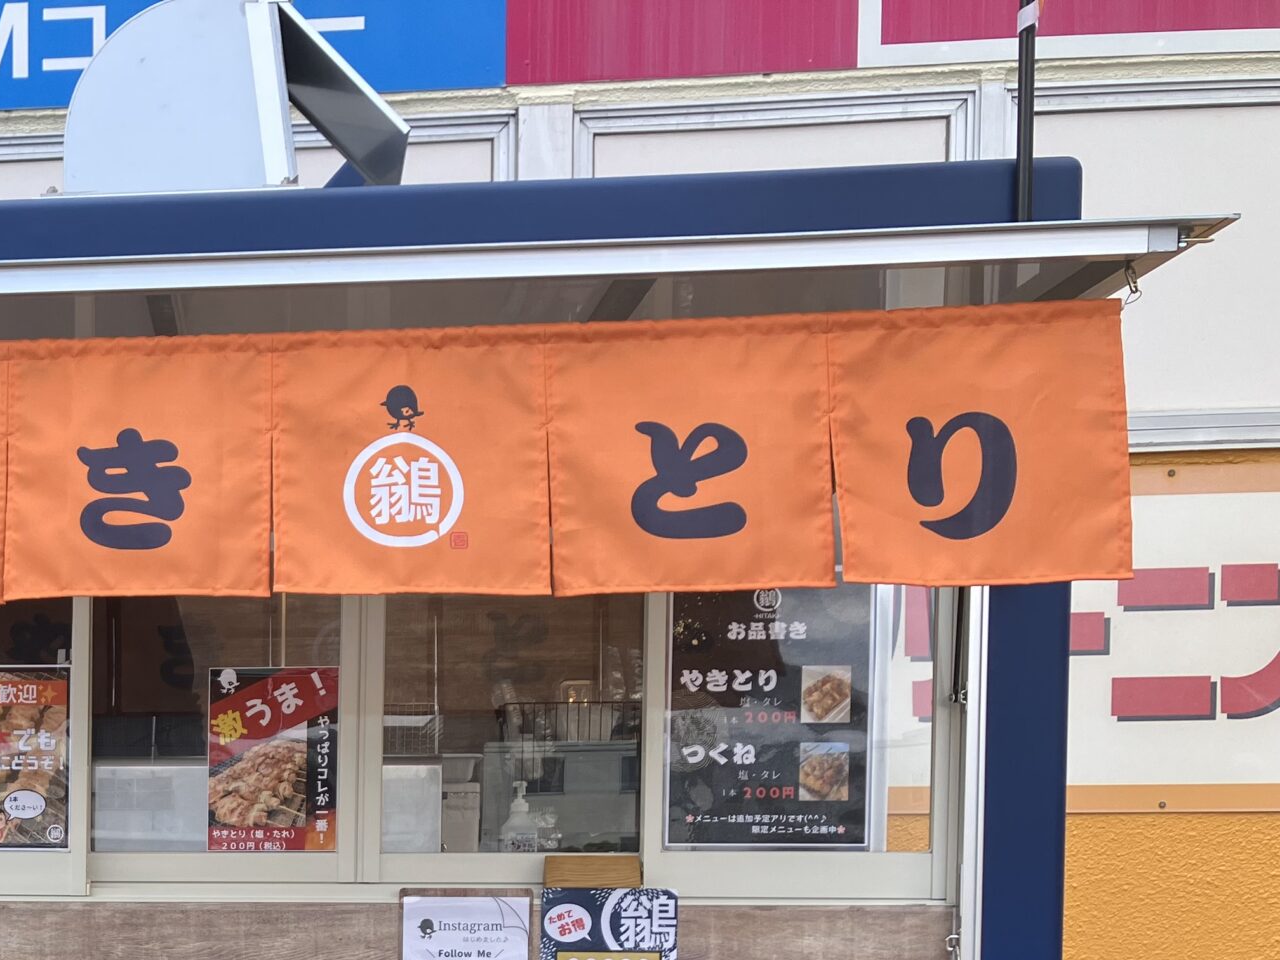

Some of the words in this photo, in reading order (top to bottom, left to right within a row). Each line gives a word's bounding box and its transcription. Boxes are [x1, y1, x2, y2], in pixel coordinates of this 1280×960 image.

[727, 622, 807, 640] お品書き
[680, 668, 778, 692] やきとり
[682, 742, 756, 766] つくね
[315, 715, 330, 844] やっぱりコレが一番！
[743, 786, 795, 800] 200円
[548, 909, 574, 925] ためて
[438, 920, 503, 934] Instagram
[557, 917, 586, 937] お得
[438, 949, 472, 958] Follow
[477, 950, 492, 958] Me
